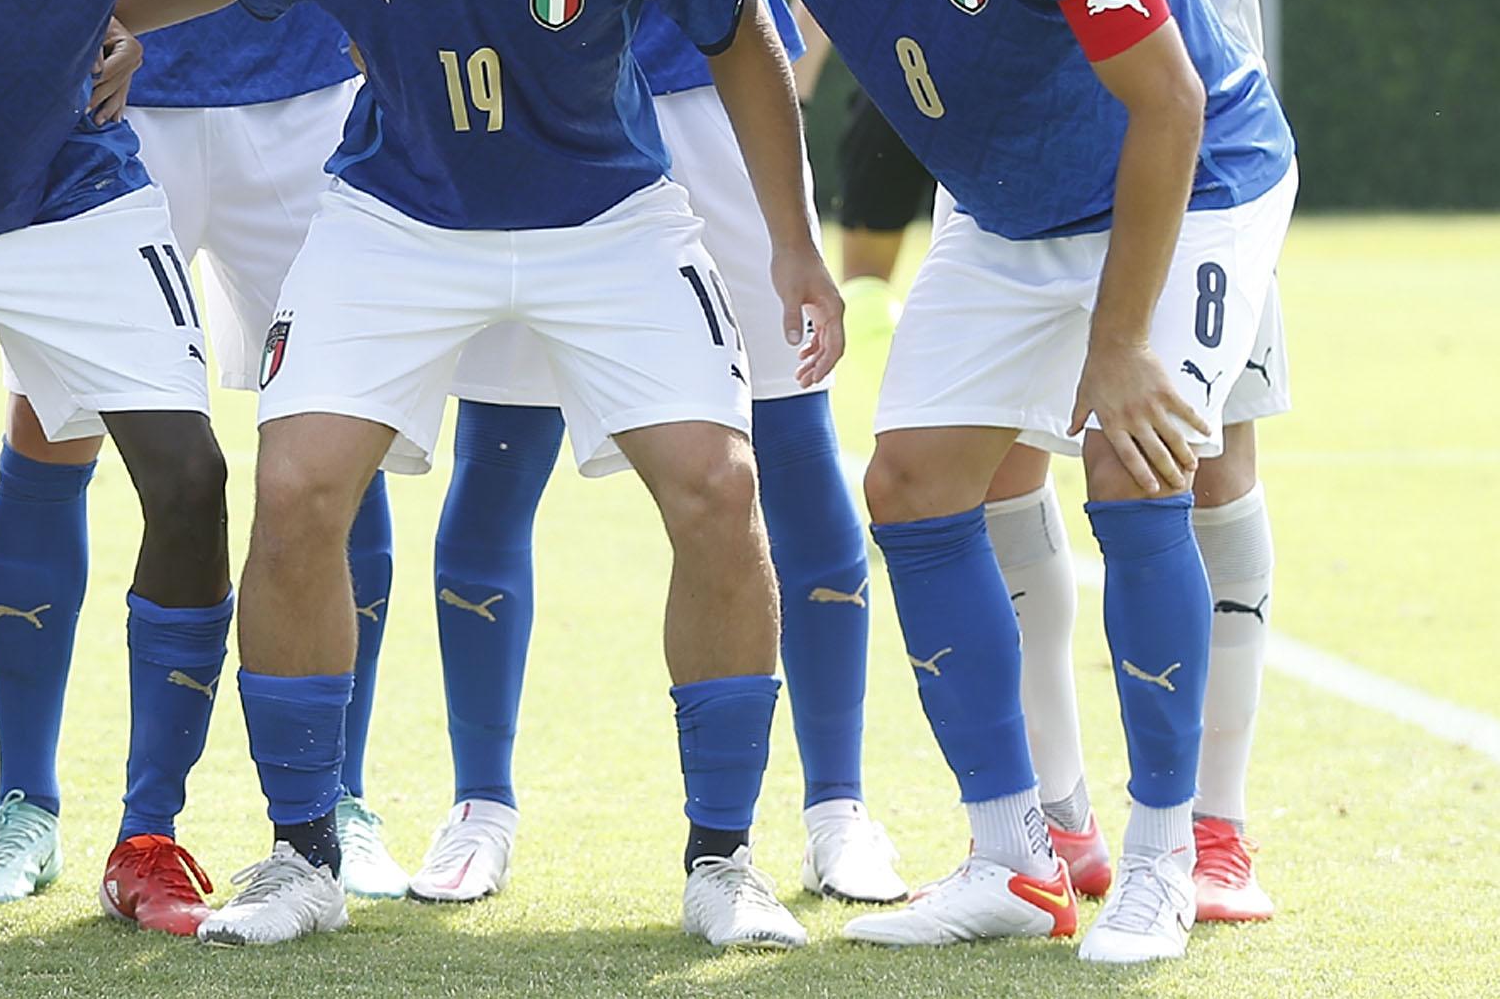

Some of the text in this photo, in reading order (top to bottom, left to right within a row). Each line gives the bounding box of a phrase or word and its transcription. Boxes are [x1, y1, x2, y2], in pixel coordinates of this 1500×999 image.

[438, 47, 504, 133] 19
[895, 36, 945, 119] 8
[139, 244, 199, 329] 11
[1194, 261, 1227, 349] 8
